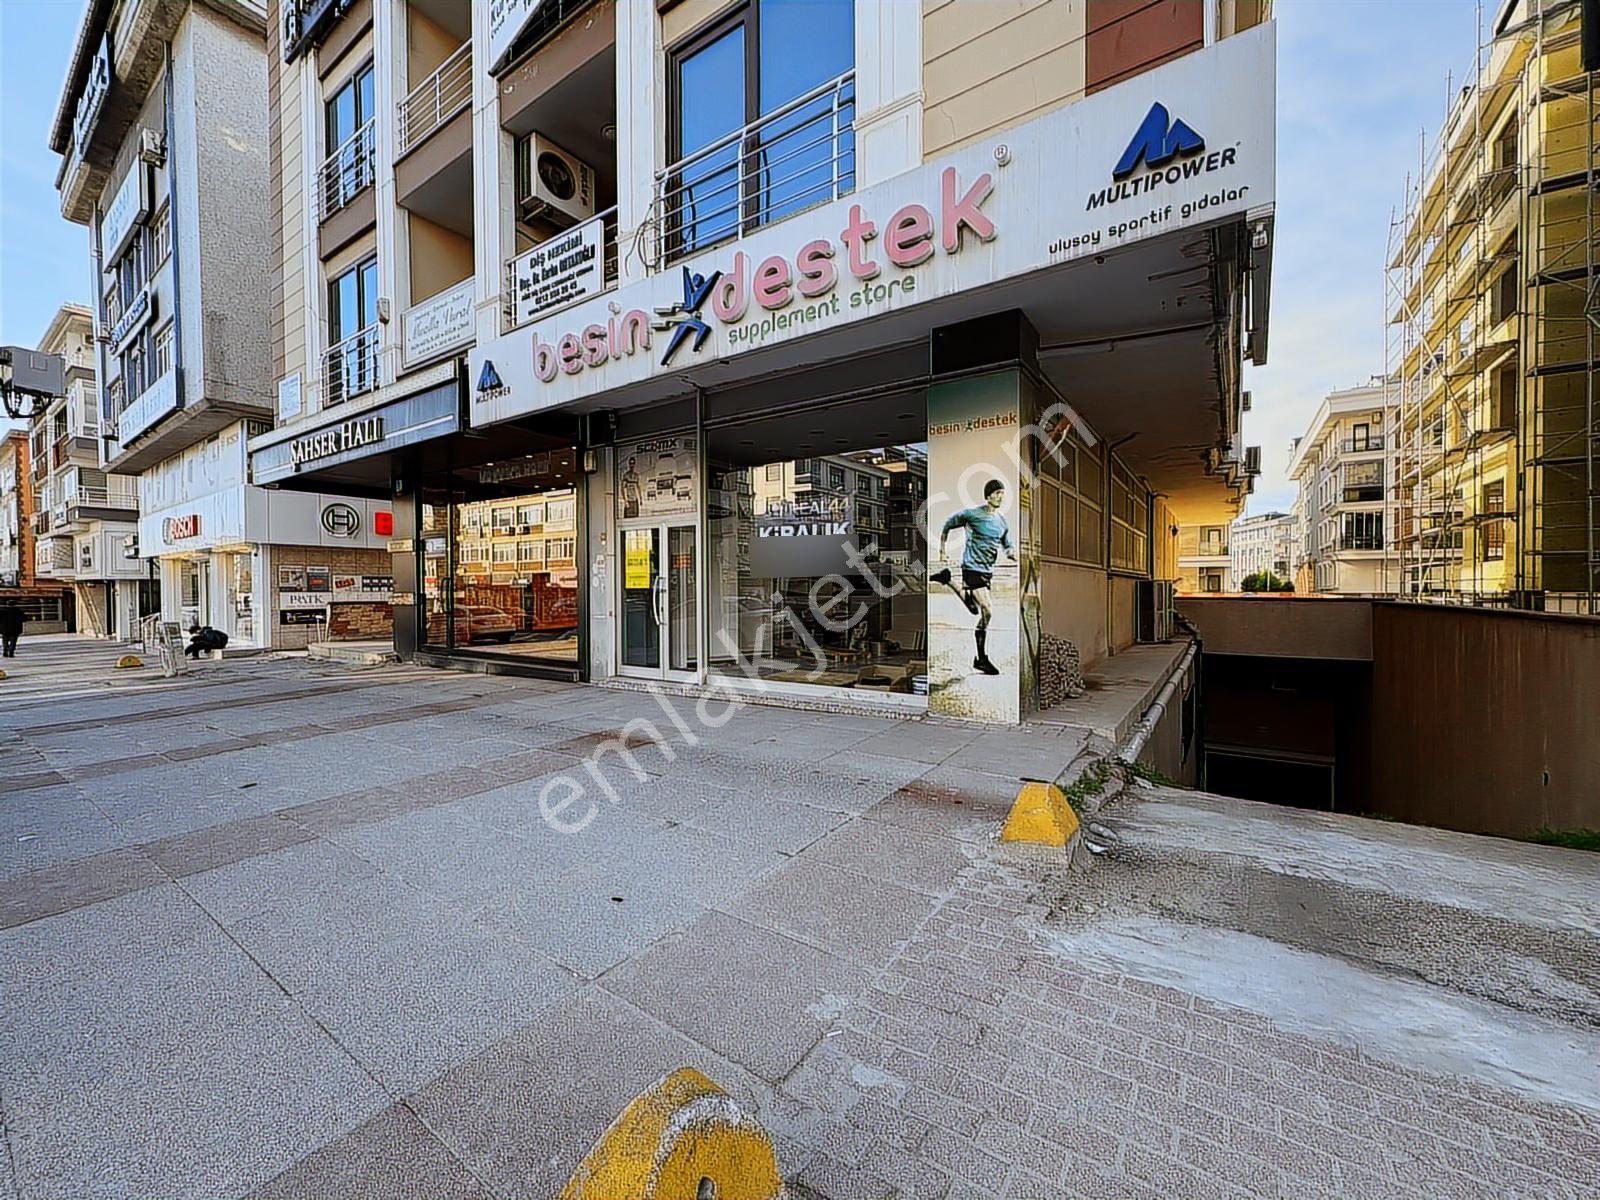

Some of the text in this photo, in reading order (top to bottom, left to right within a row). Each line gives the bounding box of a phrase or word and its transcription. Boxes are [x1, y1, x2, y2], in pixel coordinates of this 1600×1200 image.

[1086, 145, 1239, 212] MULTIPOWER
[1048, 185, 1249, 255] ulusoy sportif gıdalar
[530, 166, 999, 383] besin destek
[727, 272, 916, 346] supplement store
[929, 412, 1018, 436] besin destek
